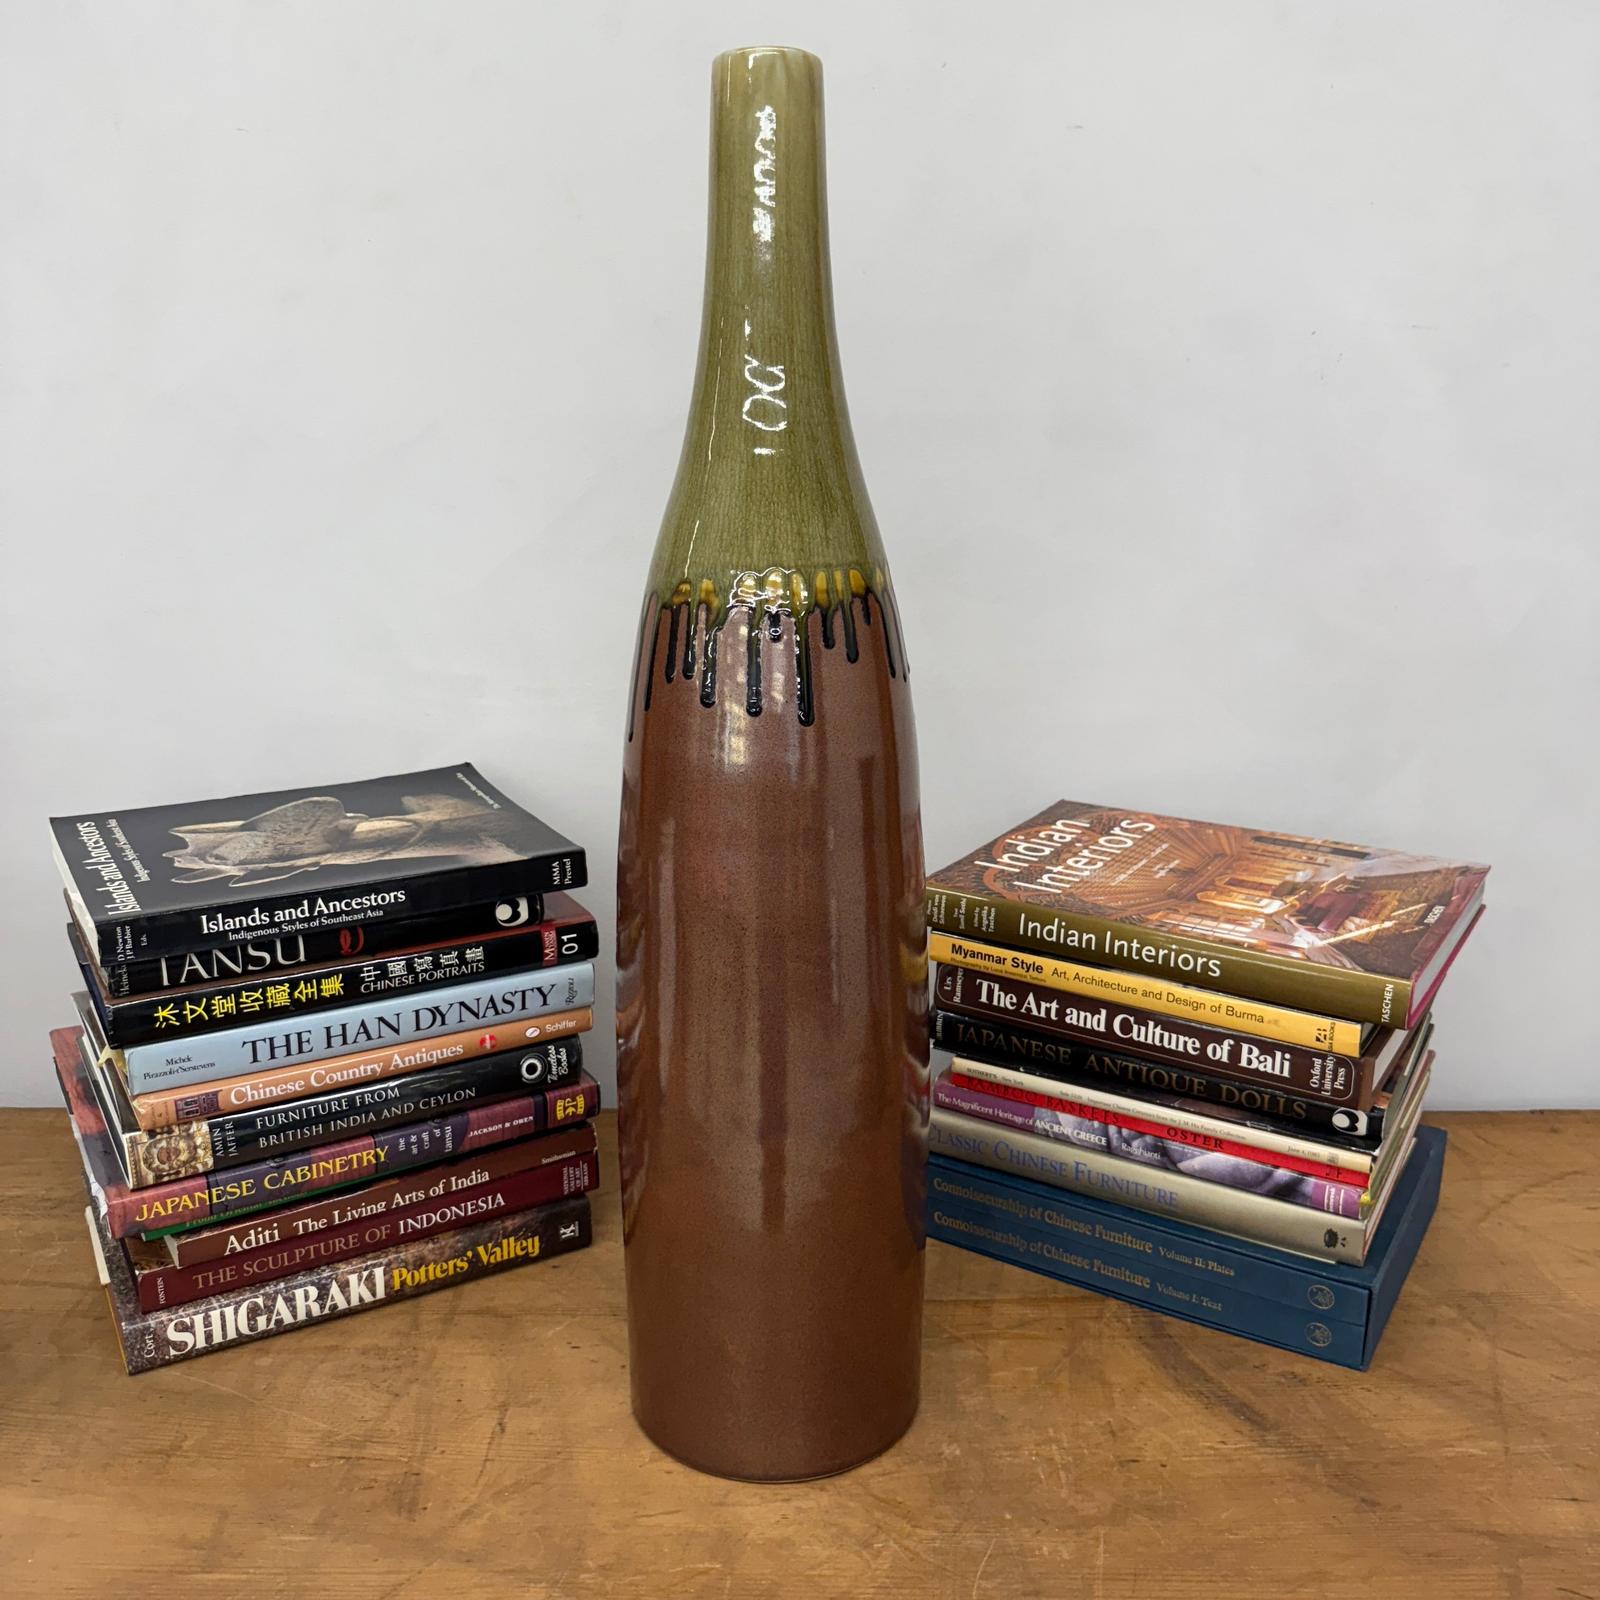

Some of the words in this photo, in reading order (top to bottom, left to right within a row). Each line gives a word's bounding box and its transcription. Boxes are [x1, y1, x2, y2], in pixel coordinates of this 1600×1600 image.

[76, 821, 115, 864] Ancestors
[974, 818, 1091, 873] Indian
[1013, 818, 1157, 895] Interiors
[85, 861, 124, 883] and
[552, 861, 561, 885] MMA
[563, 858, 572, 885] Prestel
[96, 880, 142, 916] Islands
[200, 906, 270, 934] Islands
[274, 900, 310, 922] and
[314, 888, 406, 916] Ancestors
[116, 926, 124, 953] Newton
[125, 925, 134, 949] Barbier
[229, 925, 280, 942] Indigenous
[282, 919, 309, 933] Styles
[310, 917, 321, 929] of
[321, 909, 364, 926] Southeast
[365, 908, 384, 920] Asia
[561, 933, 578, 955] 01
[1019, 912, 1097, 951] Indian
[1104, 930, 1222, 978] Interiors
[361, 976, 416, 995] CHINESE
[418, 961, 486, 984] PORTRAITS
[951, 943, 1007, 967] Myanmar
[1011, 957, 1044, 975] Style
[1052, 967, 1069, 982] Art,
[1073, 971, 1138, 996] Architecture
[1141, 987, 1162, 1001] and
[1165, 992, 1206, 1011] Design
[1210, 1002, 1222, 1014] of
[1225, 1005, 1265, 1024] Burma
[242, 1029, 314, 1065] THE
[324, 1012, 402, 1051] HAN
[412, 983, 557, 1033] DYNASTY
[1381, 983, 1394, 1024] TASCHEN
[544, 1019, 577, 1033] Schiffer
[976, 979, 1018, 1011] The
[1020, 991, 1059, 1021] Art
[1065, 1003, 1107, 1033] and
[1113, 1014, 1201, 1056] Culture
[1207, 1039, 1235, 1063] of
[1239, 1042, 1292, 1079] Bali
[166, 1055, 193, 1067] Michele
[230, 1074, 305, 1105] Chinese
[310, 1061, 383, 1088] Country
[389, 1044, 464, 1071] Antiques
[956, 1024, 1072, 1066] JAPANESE
[1085, 1055, 1208, 1099] ANTIQUE
[1219, 1082, 1309, 1121] DOLLS
[1309, 1057, 1322, 1088] Oxford
[1321, 1054, 1336, 1096] University
[1333, 1067, 1346, 1090] Press
[256, 1097, 349, 1131] FURNITURE
[355, 1087, 400, 1109] FROM
[259, 1124, 324, 1149] BRITISH
[330, 1112, 376, 1135] INDIA
[381, 1102, 414, 1120] AND
[419, 1087, 477, 1111] CEYLON
[468, 1123, 503, 1138] JACKSON
[504, 1121, 511, 1129] &
[513, 1115, 534, 1127] OWEN
[936, 1092, 952, 1104] The
[952, 1096, 995, 1115] Magnificent
[993, 1106, 1026, 1123] Heritage
[1026, 1114, 1035, 1126] of
[1035, 1118, 1071, 1137] ANCIENT
[1073, 1127, 1109, 1147] GREECE
[1047, 1096, 1120, 1126] BASKETS
[1166, 1127, 1225, 1151] OSTER
[212, 1127, 225, 1158] AMIN
[227, 1120, 239, 1158] JAFFER
[421, 1130, 430, 1150] craft
[433, 1128, 441, 1138] of
[444, 1126, 453, 1153] tansu
[135, 1178, 257, 1223] JAPANESE
[263, 1146, 390, 1191] CABINETRY
[992, 1140, 1069, 1178] CHINESE
[1073, 1160, 1179, 1207] FURNITURE
[224, 1222, 281, 1256] Aditi
[293, 1213, 328, 1235] The
[331, 1201, 386, 1226] Living
[391, 1188, 425, 1209] Arts
[429, 1181, 448, 1200] of
[450, 1168, 490, 1192] India
[934, 1178, 1029, 1218] Connoisseurship
[1029, 1206, 1043, 1220] of
[1044, 1209, 1092, 1236] Chinese
[1094, 1220, 1153, 1253] Furniture
[1158, 1245, 1193, 1268] Volume
[1207, 1259, 1236, 1277] Plates
[192, 1266, 239, 1290] THE
[243, 1232, 361, 1277] SCULPTURE
[365, 1224, 391, 1246] OF
[399, 1192, 507, 1236] INDONESIA
[934, 1211, 1029, 1252] Connoisseurship
[1029, 1239, 1042, 1253] of
[1042, 1243, 1091, 1270] Chinese
[1093, 1256, 1152, 1288] Furniture
[1156, 1281, 1190, 1304] Volume
[1201, 1294, 1223, 1312] Text
[166, 1265, 387, 1358] SHIGARAKI
[391, 1248, 473, 1292] Potters'
[475, 1234, 541, 1268] Valley
[143, 1333, 156, 1359] Cort
